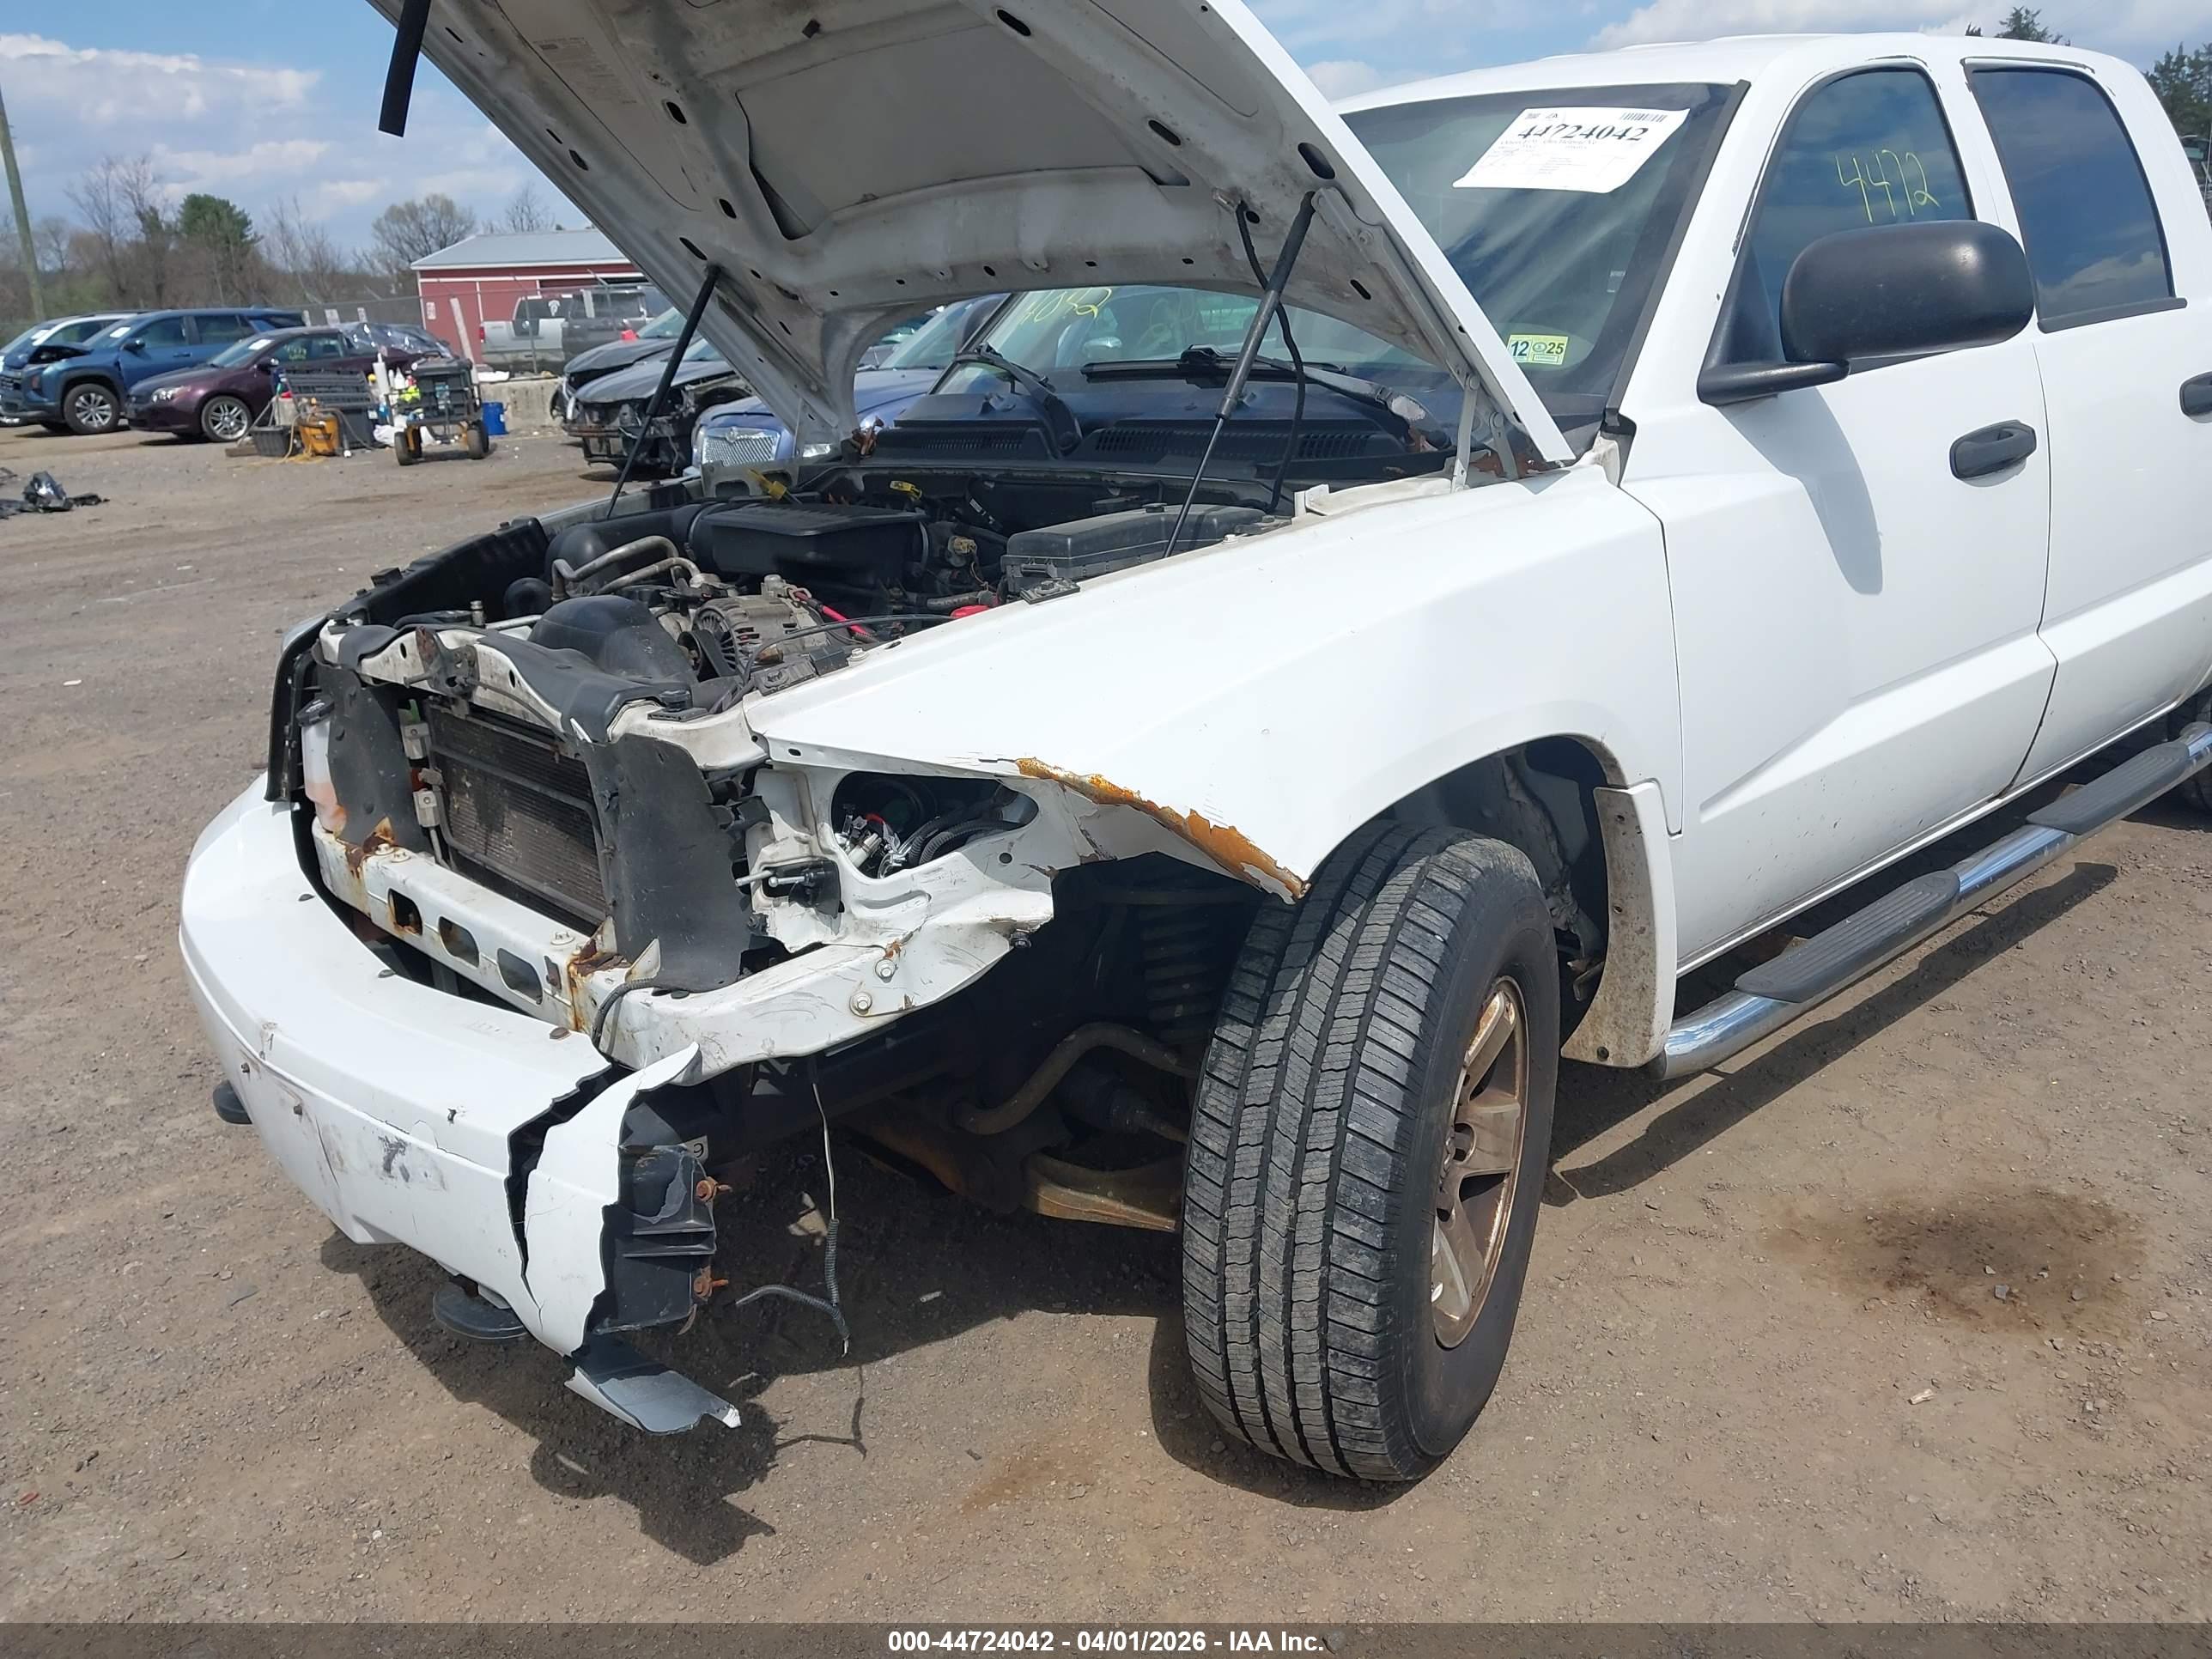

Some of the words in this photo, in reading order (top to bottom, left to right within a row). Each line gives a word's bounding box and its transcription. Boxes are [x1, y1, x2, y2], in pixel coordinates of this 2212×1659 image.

[1517, 123, 1649, 142] 44724042
[1834, 149, 1942, 223] 4472
[1510, 340, 1529, 356] 12
[1547, 342, 1565, 355] 25
